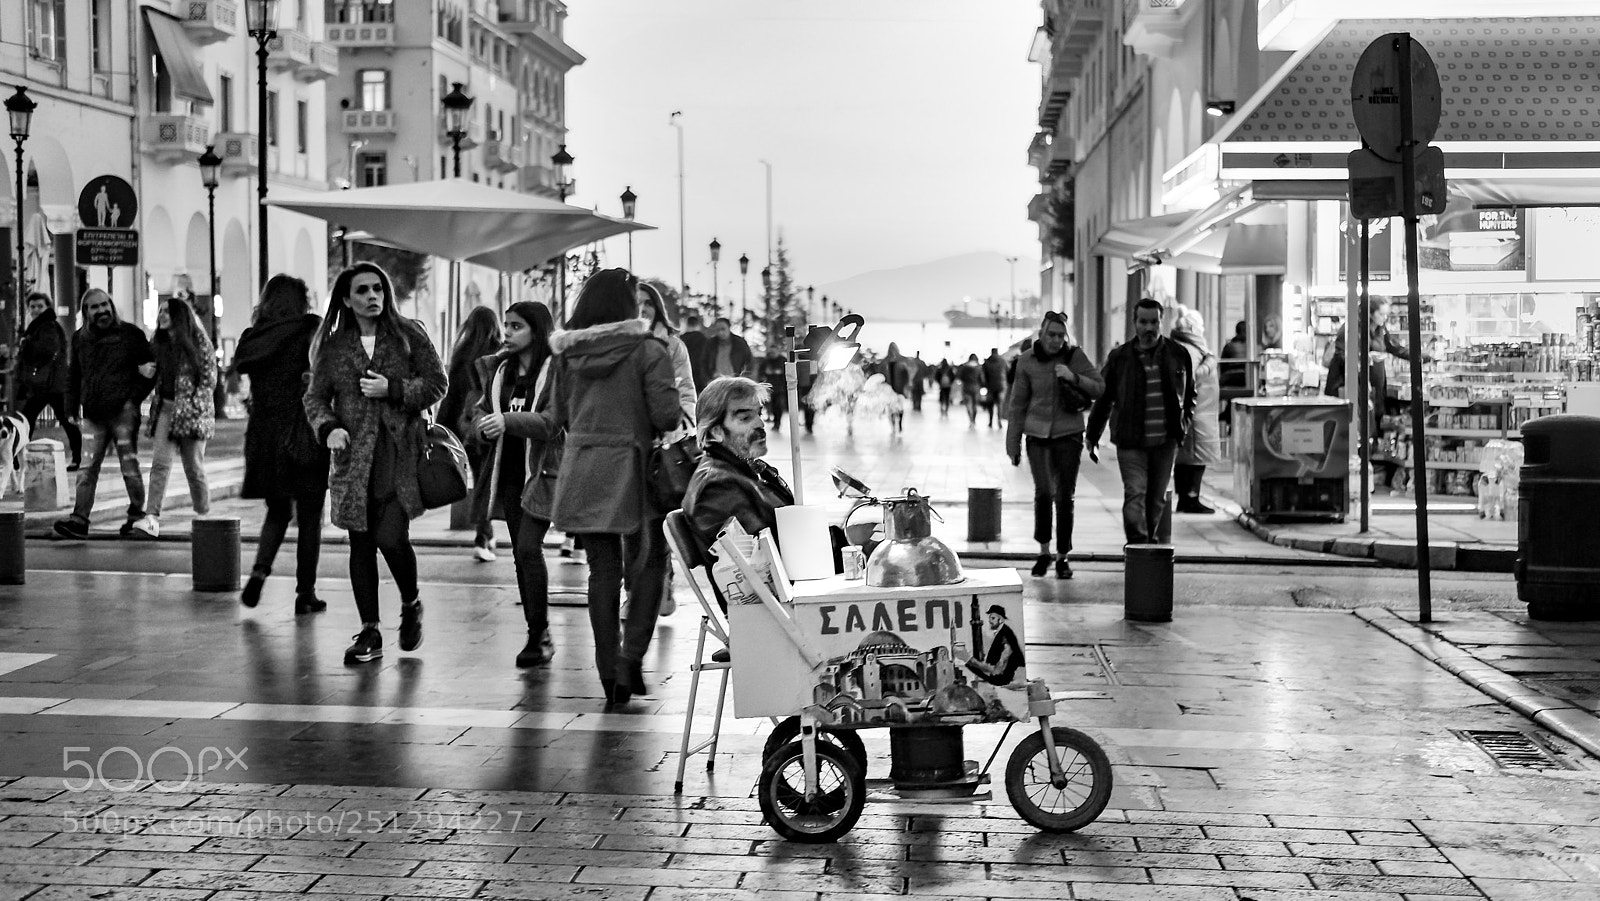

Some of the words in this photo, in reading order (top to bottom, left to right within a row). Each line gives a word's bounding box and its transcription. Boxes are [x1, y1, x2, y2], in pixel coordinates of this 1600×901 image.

[1479, 211, 1498, 221] FOR
[1479, 220, 1517, 230] HUNTERS
[819, 600, 963, 635] ΣΑΛΕΠΙ
